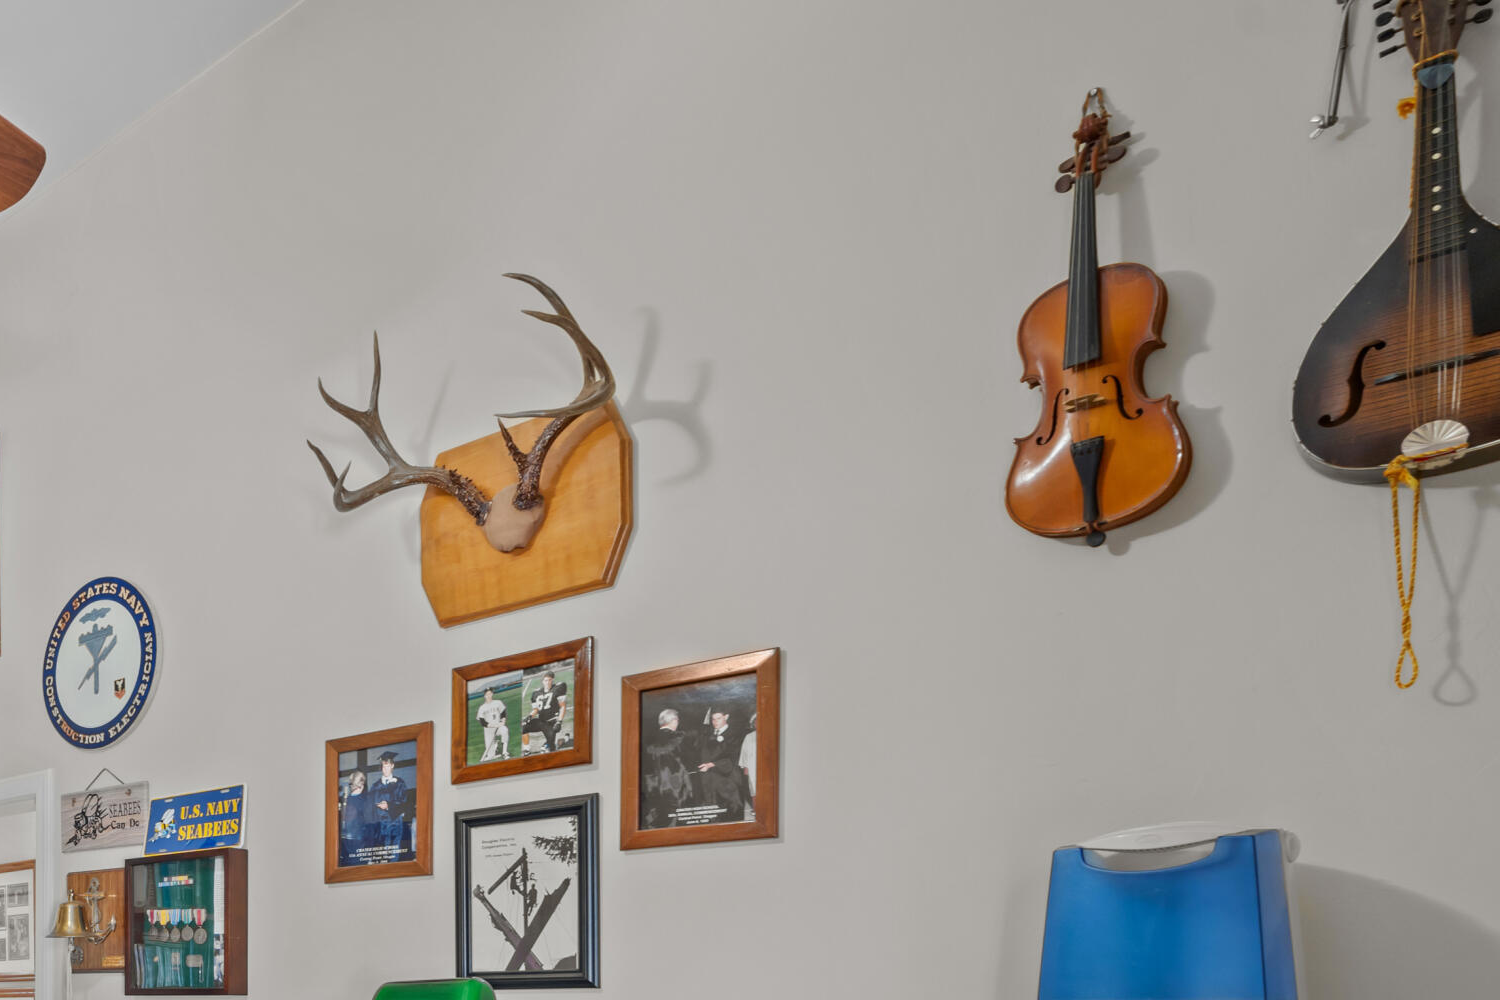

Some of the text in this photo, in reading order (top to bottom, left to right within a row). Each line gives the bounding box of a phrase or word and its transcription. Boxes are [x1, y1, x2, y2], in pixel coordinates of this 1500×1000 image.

[45, 583, 150, 670] UNITED STATES NAVY
[45, 632, 153, 744] CONSTRUCTION ELECTRICIAN
[535, 692, 554, 711] 67
[109, 801, 141, 818] SEABEES
[180, 798, 241, 820] U.S. NAVY
[111, 818, 139, 829] Can Do
[177, 818, 239, 841] SEABEES
